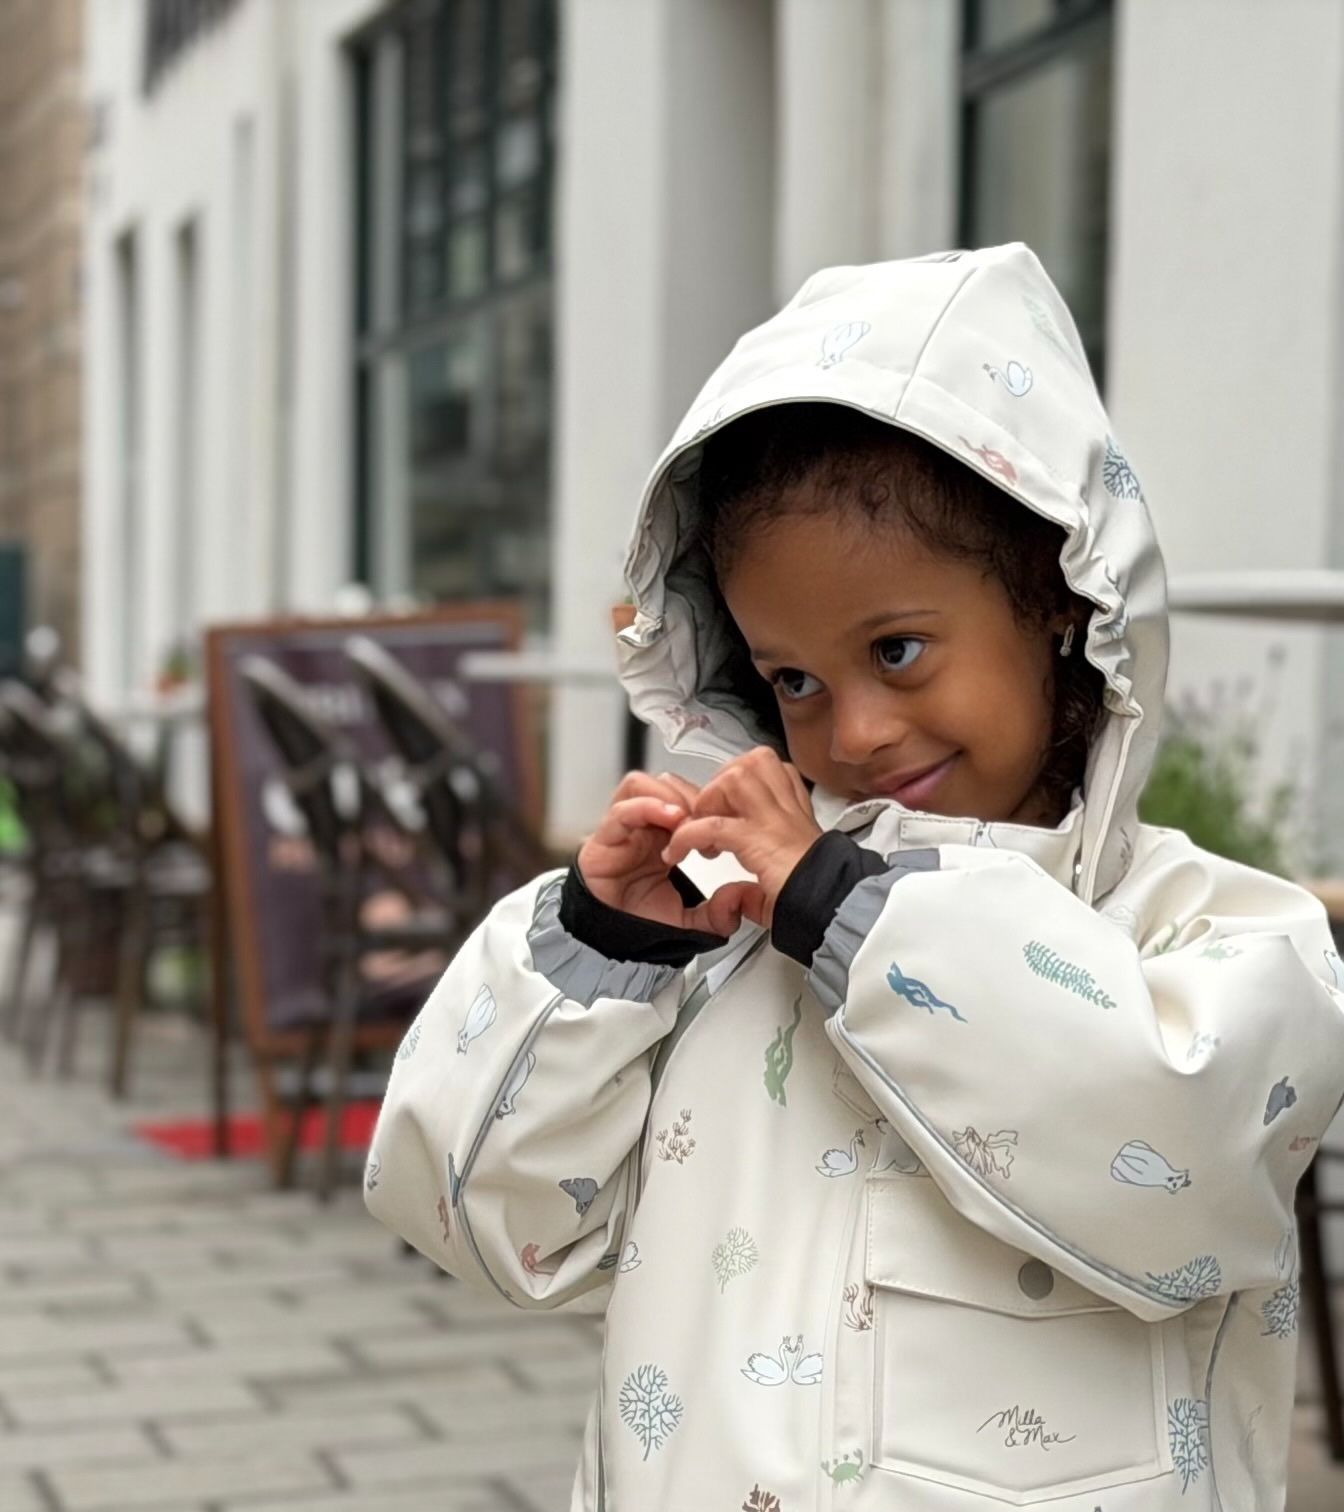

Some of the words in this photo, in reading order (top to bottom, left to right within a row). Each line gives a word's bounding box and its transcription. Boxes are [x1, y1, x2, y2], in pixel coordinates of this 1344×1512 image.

[976, 1404, 1047, 1434] Milla
[1004, 1427, 1021, 1448] &
[1021, 1425, 1077, 1452] Max
